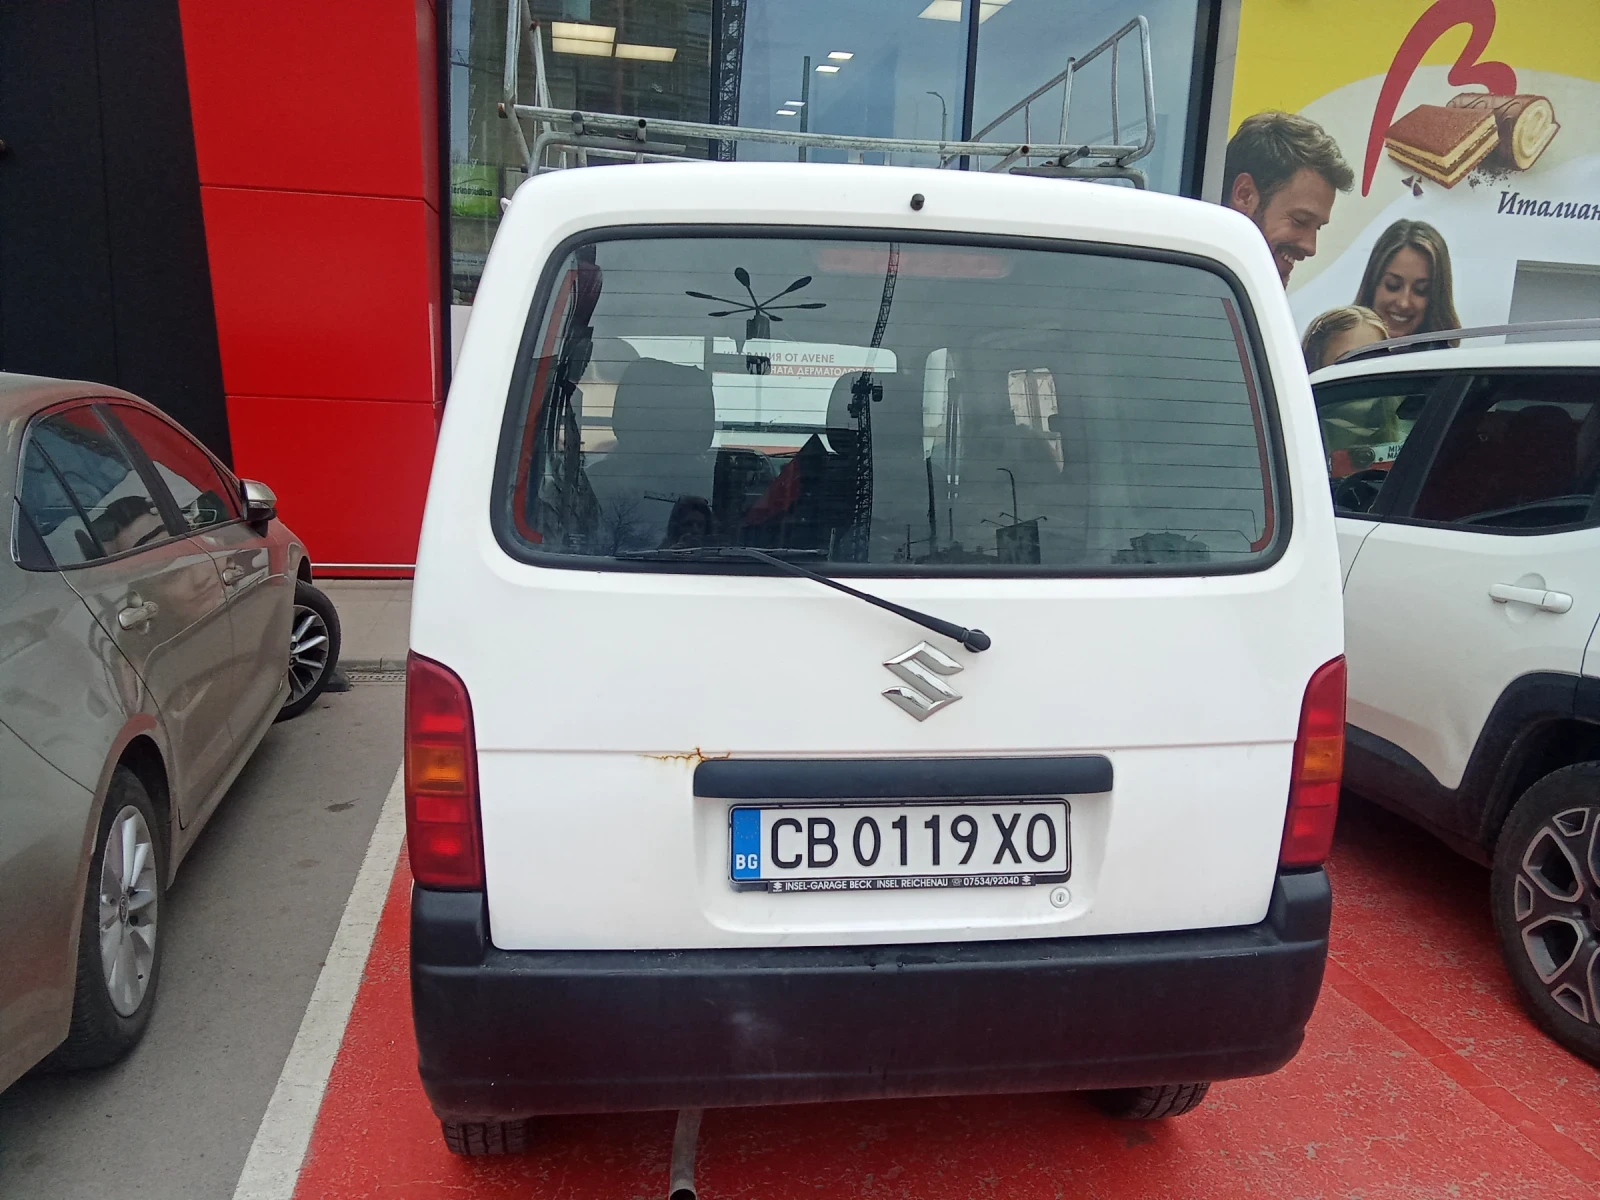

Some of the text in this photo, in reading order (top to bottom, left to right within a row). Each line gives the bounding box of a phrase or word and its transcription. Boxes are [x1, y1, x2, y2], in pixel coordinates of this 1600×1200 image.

[800, 353, 835, 363] AVENE
[770, 812, 1057, 869] CB 0119 XO
[735, 853, 758, 870] BG
[785, 876, 1020, 891] INSEL-GARAGE BECK INSEL REICHENAU 07534/92040
